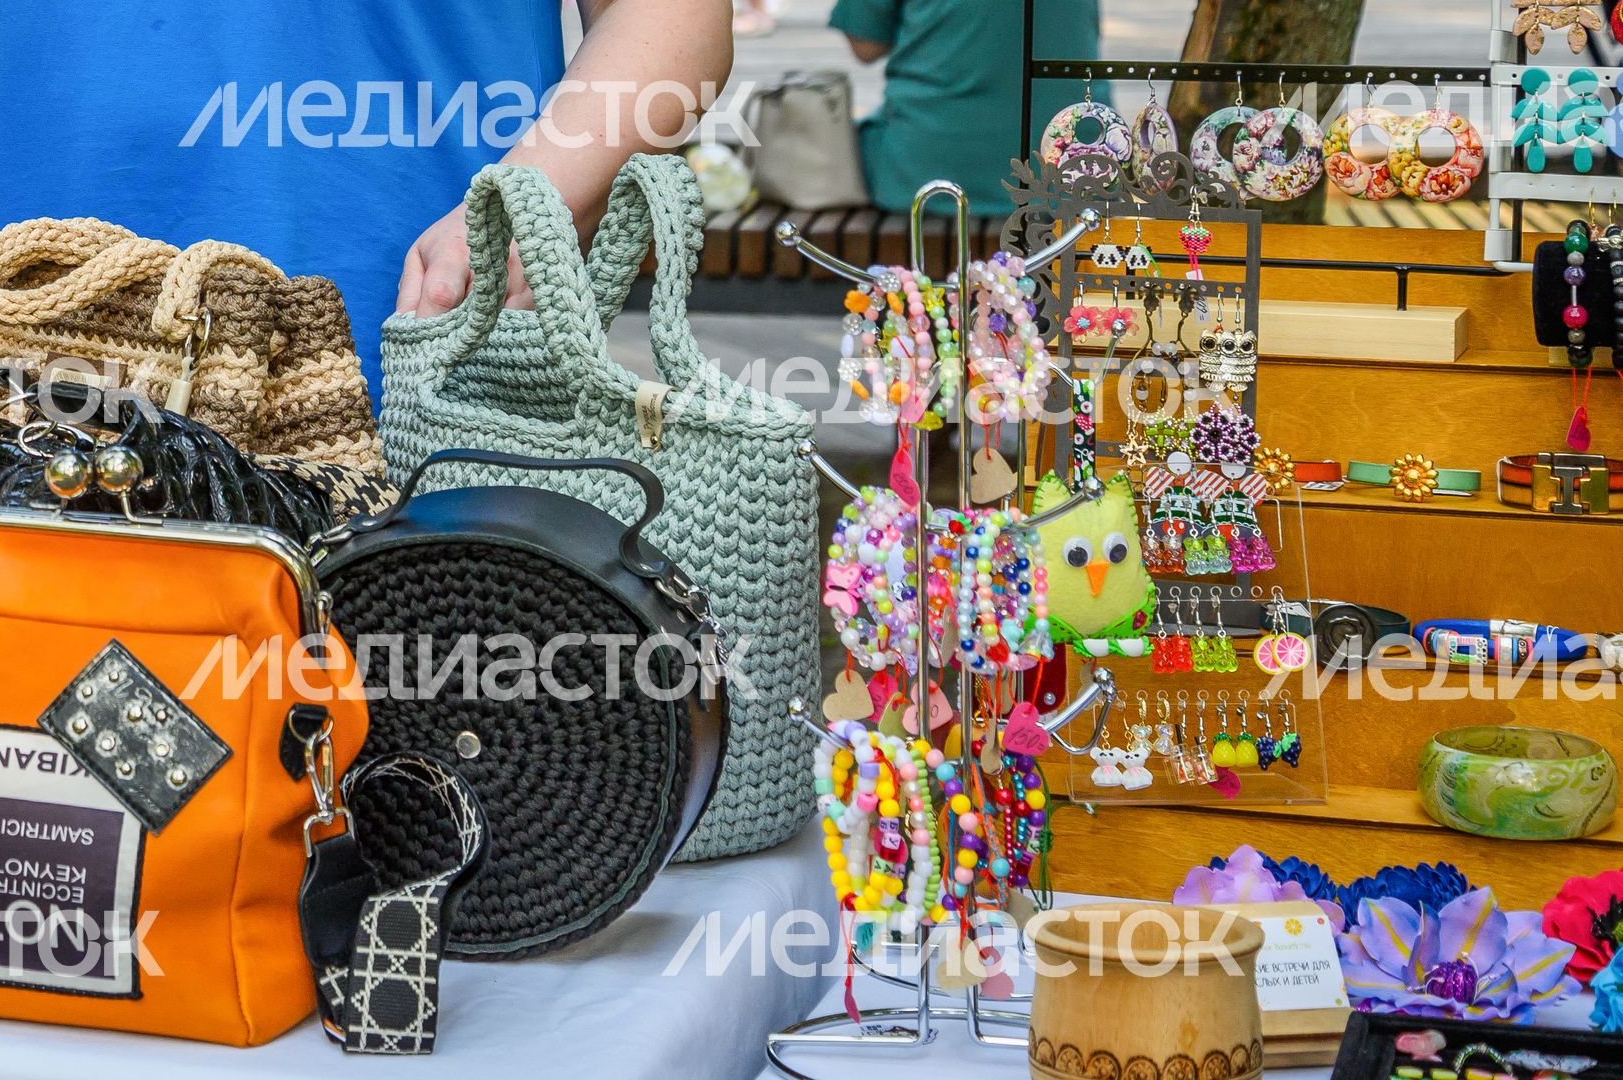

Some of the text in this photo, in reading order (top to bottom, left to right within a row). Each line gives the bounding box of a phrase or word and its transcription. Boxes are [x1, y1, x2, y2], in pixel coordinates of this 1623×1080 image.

[1272, 961, 1310, 974] ВСТРЕЧИ
[1313, 960, 1331, 971] ДЛЯ
[1283, 976, 1290, 986] И
[1292, 972, 1320, 986] ДЕТЕЙ
